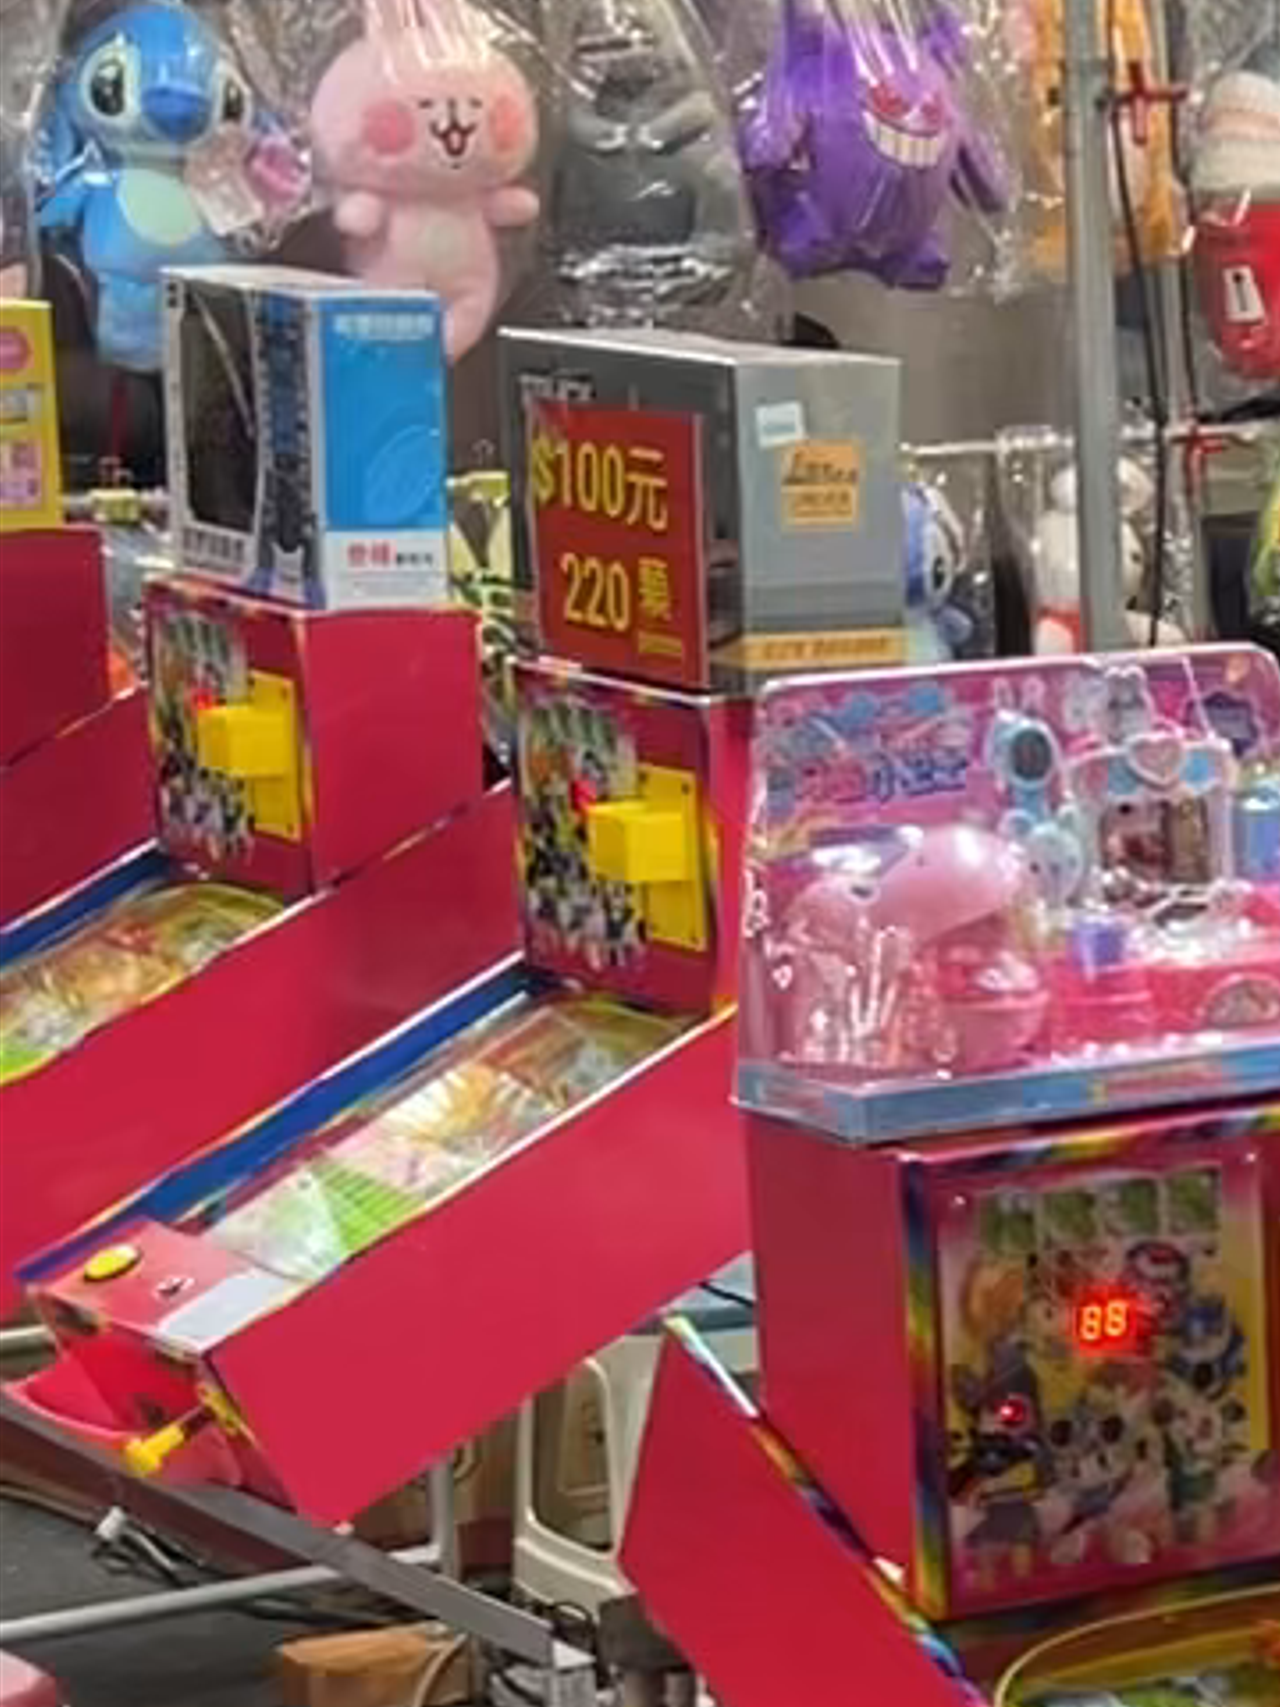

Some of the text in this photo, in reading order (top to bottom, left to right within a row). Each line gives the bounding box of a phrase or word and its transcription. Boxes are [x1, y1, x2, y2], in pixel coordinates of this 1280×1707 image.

[530, 436, 669, 532] $100元
[560, 552, 631, 632] 220
[1079, 1299, 1129, 1341] 88
